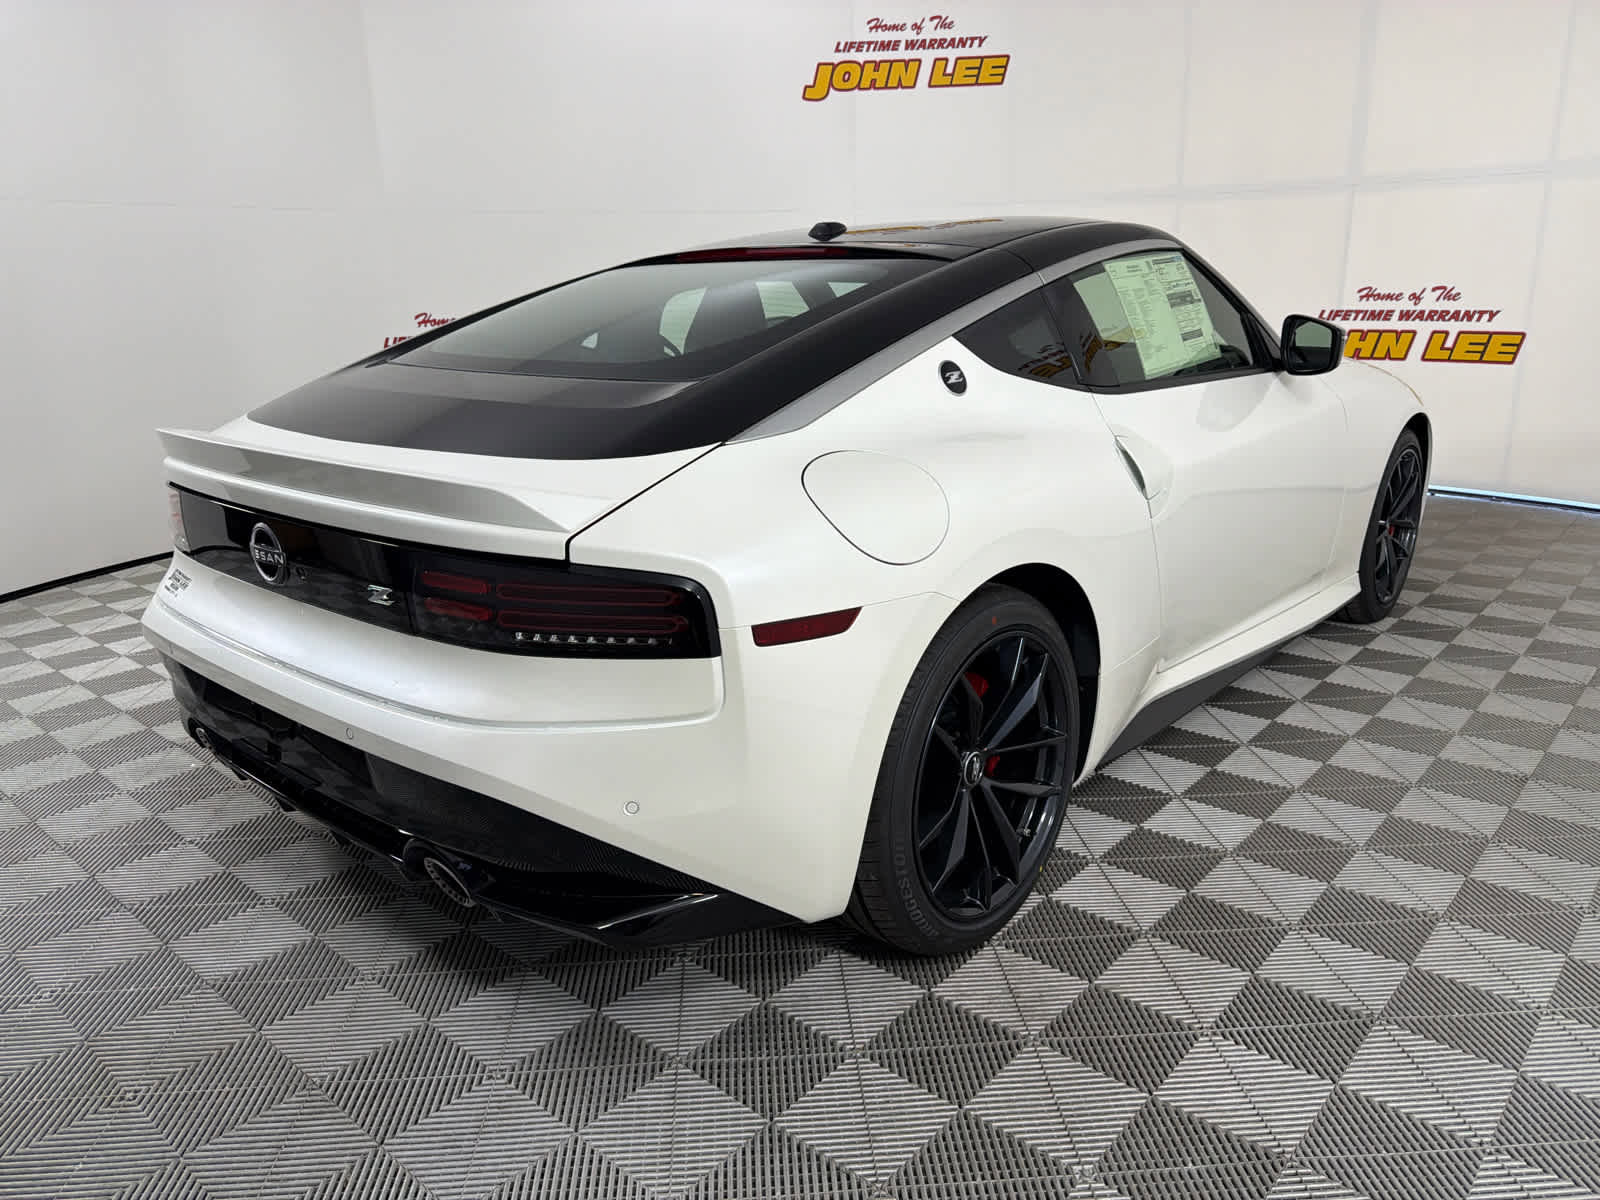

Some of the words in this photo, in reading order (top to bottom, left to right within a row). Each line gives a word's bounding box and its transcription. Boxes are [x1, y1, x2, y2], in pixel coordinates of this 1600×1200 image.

[866, 17, 907, 33] Home
[910, 18, 926, 35] of
[929, 15, 955, 31] The
[833, 39, 901, 53] LIFETIME
[904, 35, 988, 50] WARRANTY
[802, 58, 922, 102] JOHN
[928, 54, 1010, 88] LEE
[1356, 286, 1404, 302] Home
[1407, 287, 1426, 306] of
[1431, 285, 1462, 302] The
[414, 312, 456, 328] Hom
[1317, 309, 1395, 322] LIFETIME
[1397, 309, 1501, 323] WARRANTY
[1343, 329, 1417, 361] HN
[1420, 330, 1527, 365] LEE
